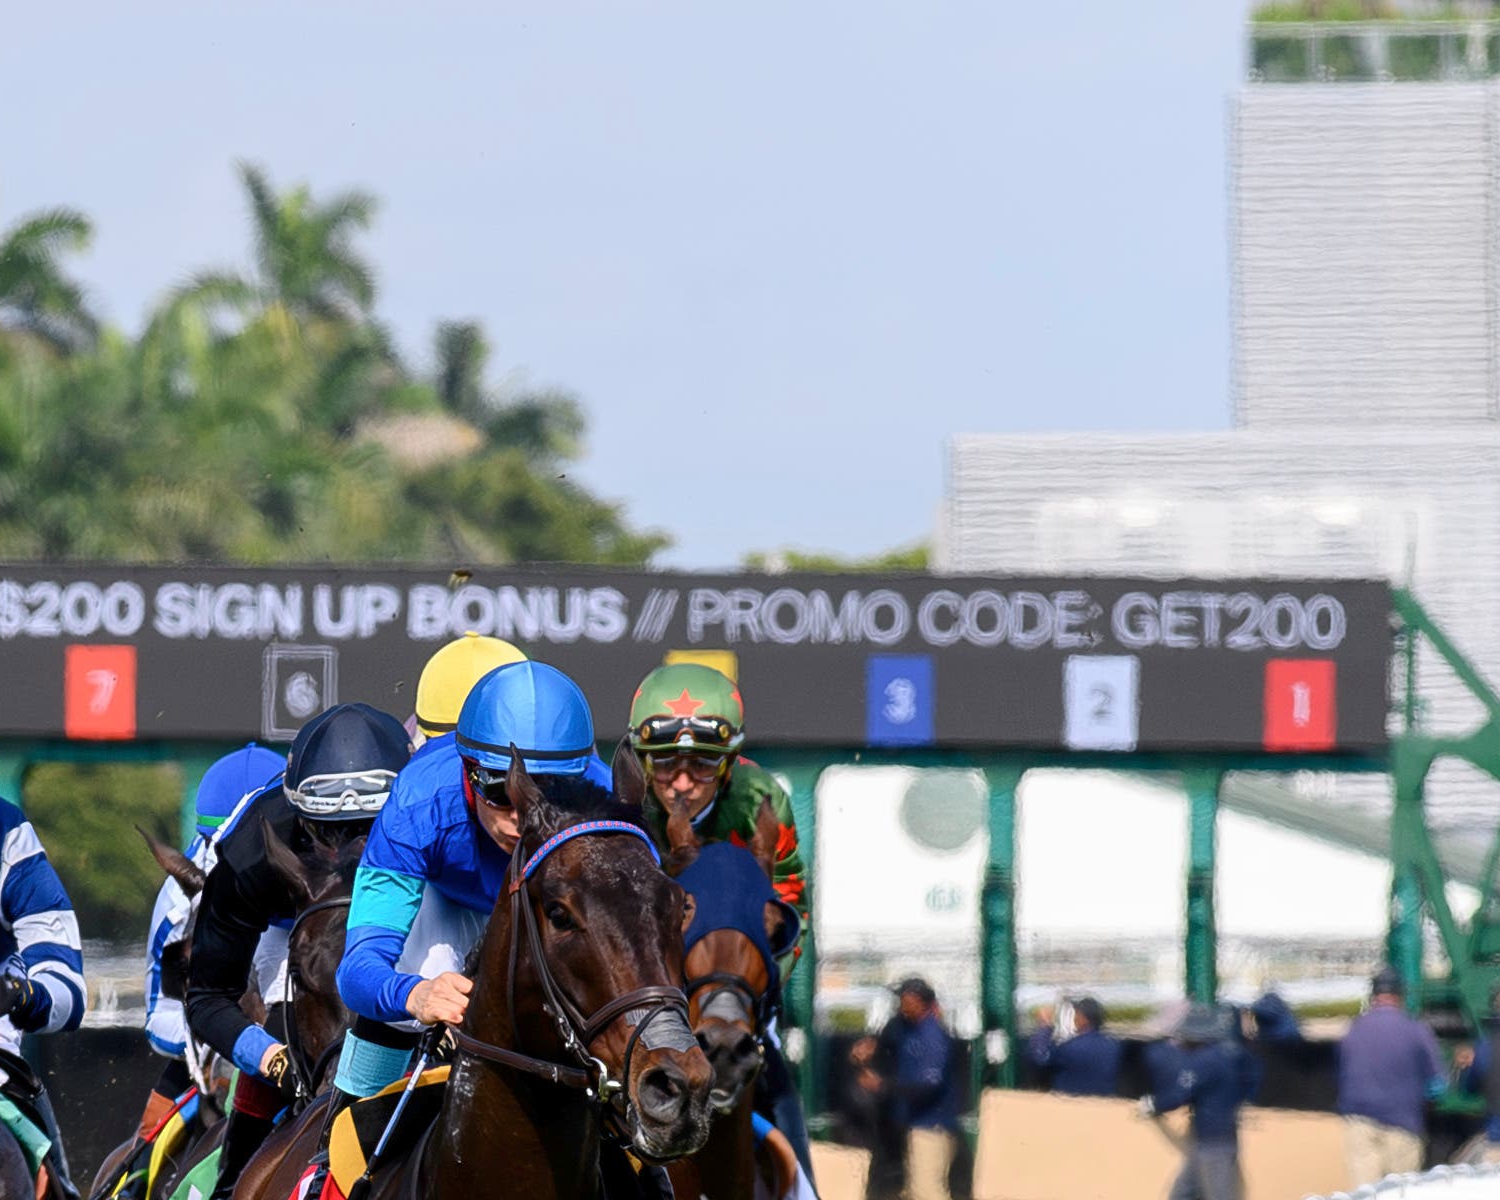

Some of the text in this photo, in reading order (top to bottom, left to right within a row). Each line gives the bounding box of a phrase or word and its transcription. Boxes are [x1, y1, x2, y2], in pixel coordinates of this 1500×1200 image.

[153, 581, 303, 640] SIGN
[312, 583, 401, 640] UP
[407, 582, 628, 643] BONUS
[686, 587, 912, 645] PROMO
[917, 589, 1103, 650] CODE:
[1112, 590, 1348, 651] GET200
[84, 669, 118, 714] 7
[285, 671, 320, 718] 6
[882, 677, 917, 724] 3
[1290, 682, 1311, 727] 1
